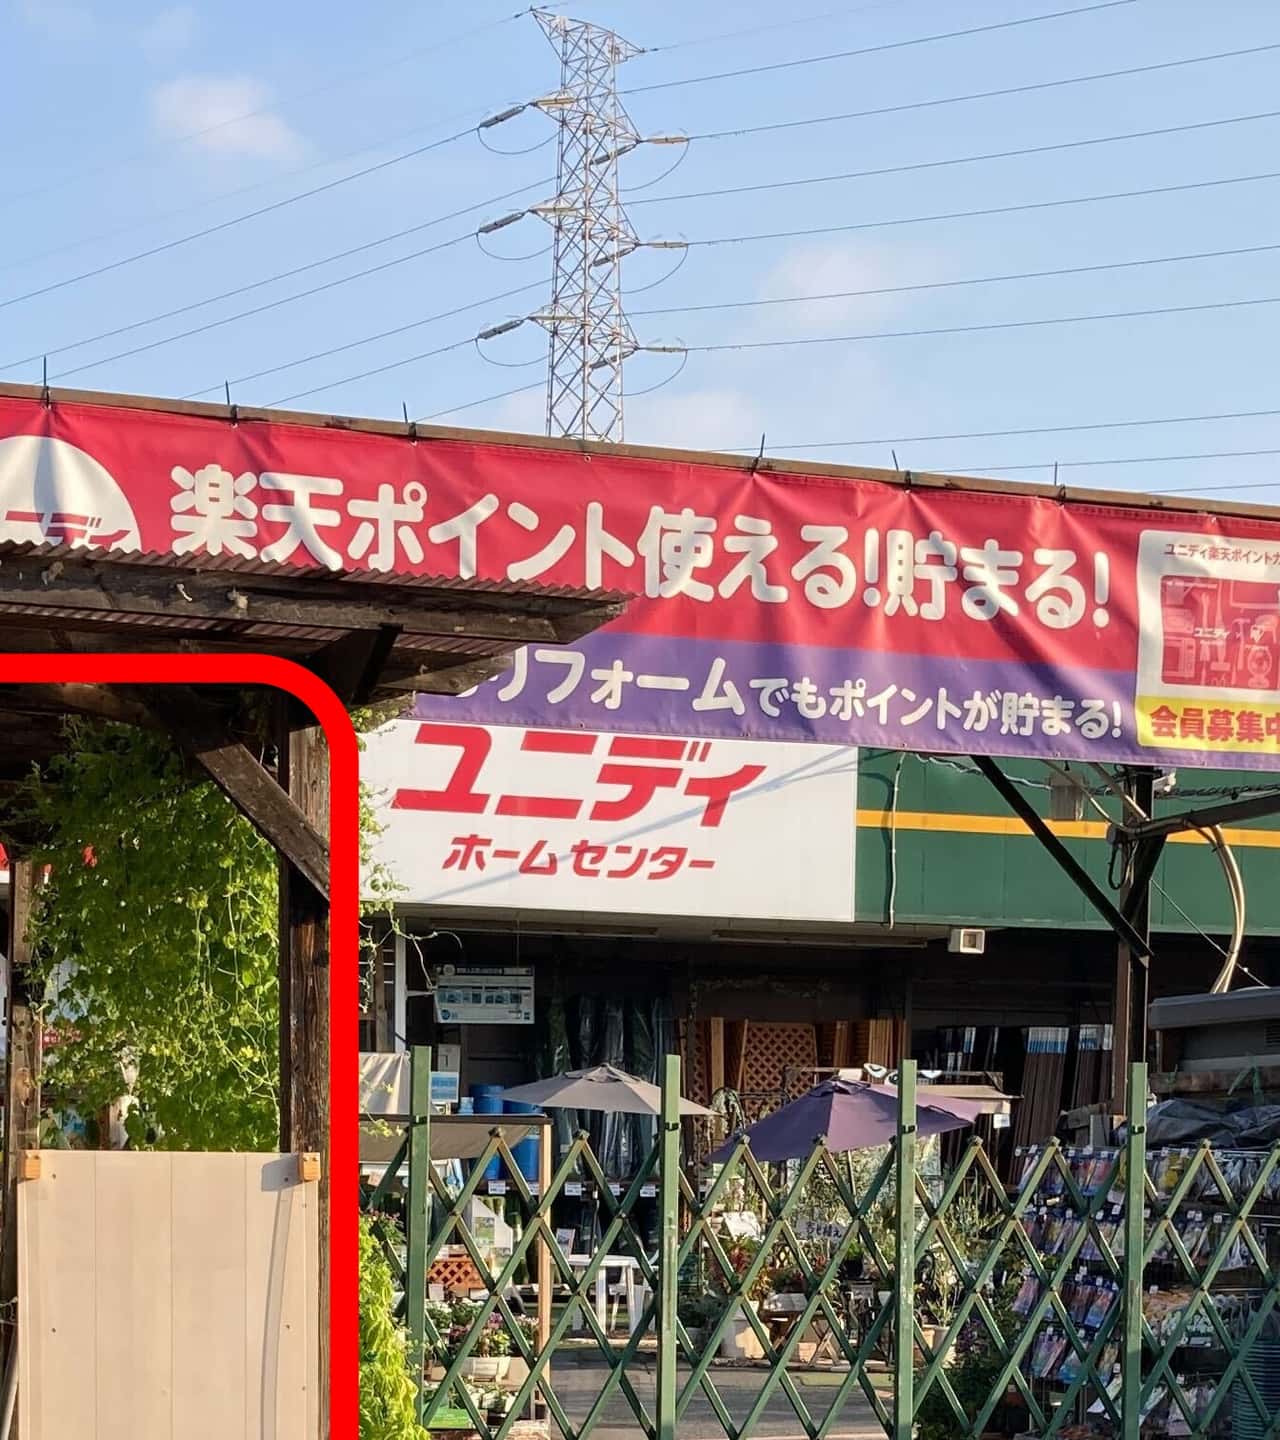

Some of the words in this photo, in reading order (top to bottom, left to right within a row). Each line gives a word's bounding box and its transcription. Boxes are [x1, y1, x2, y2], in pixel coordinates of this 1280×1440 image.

[457, 644, 1122, 740] リフォームでもポイントが貯まる!
[391, 723, 767, 829] ユニディ
[442, 834, 717, 882] ホームセンター
